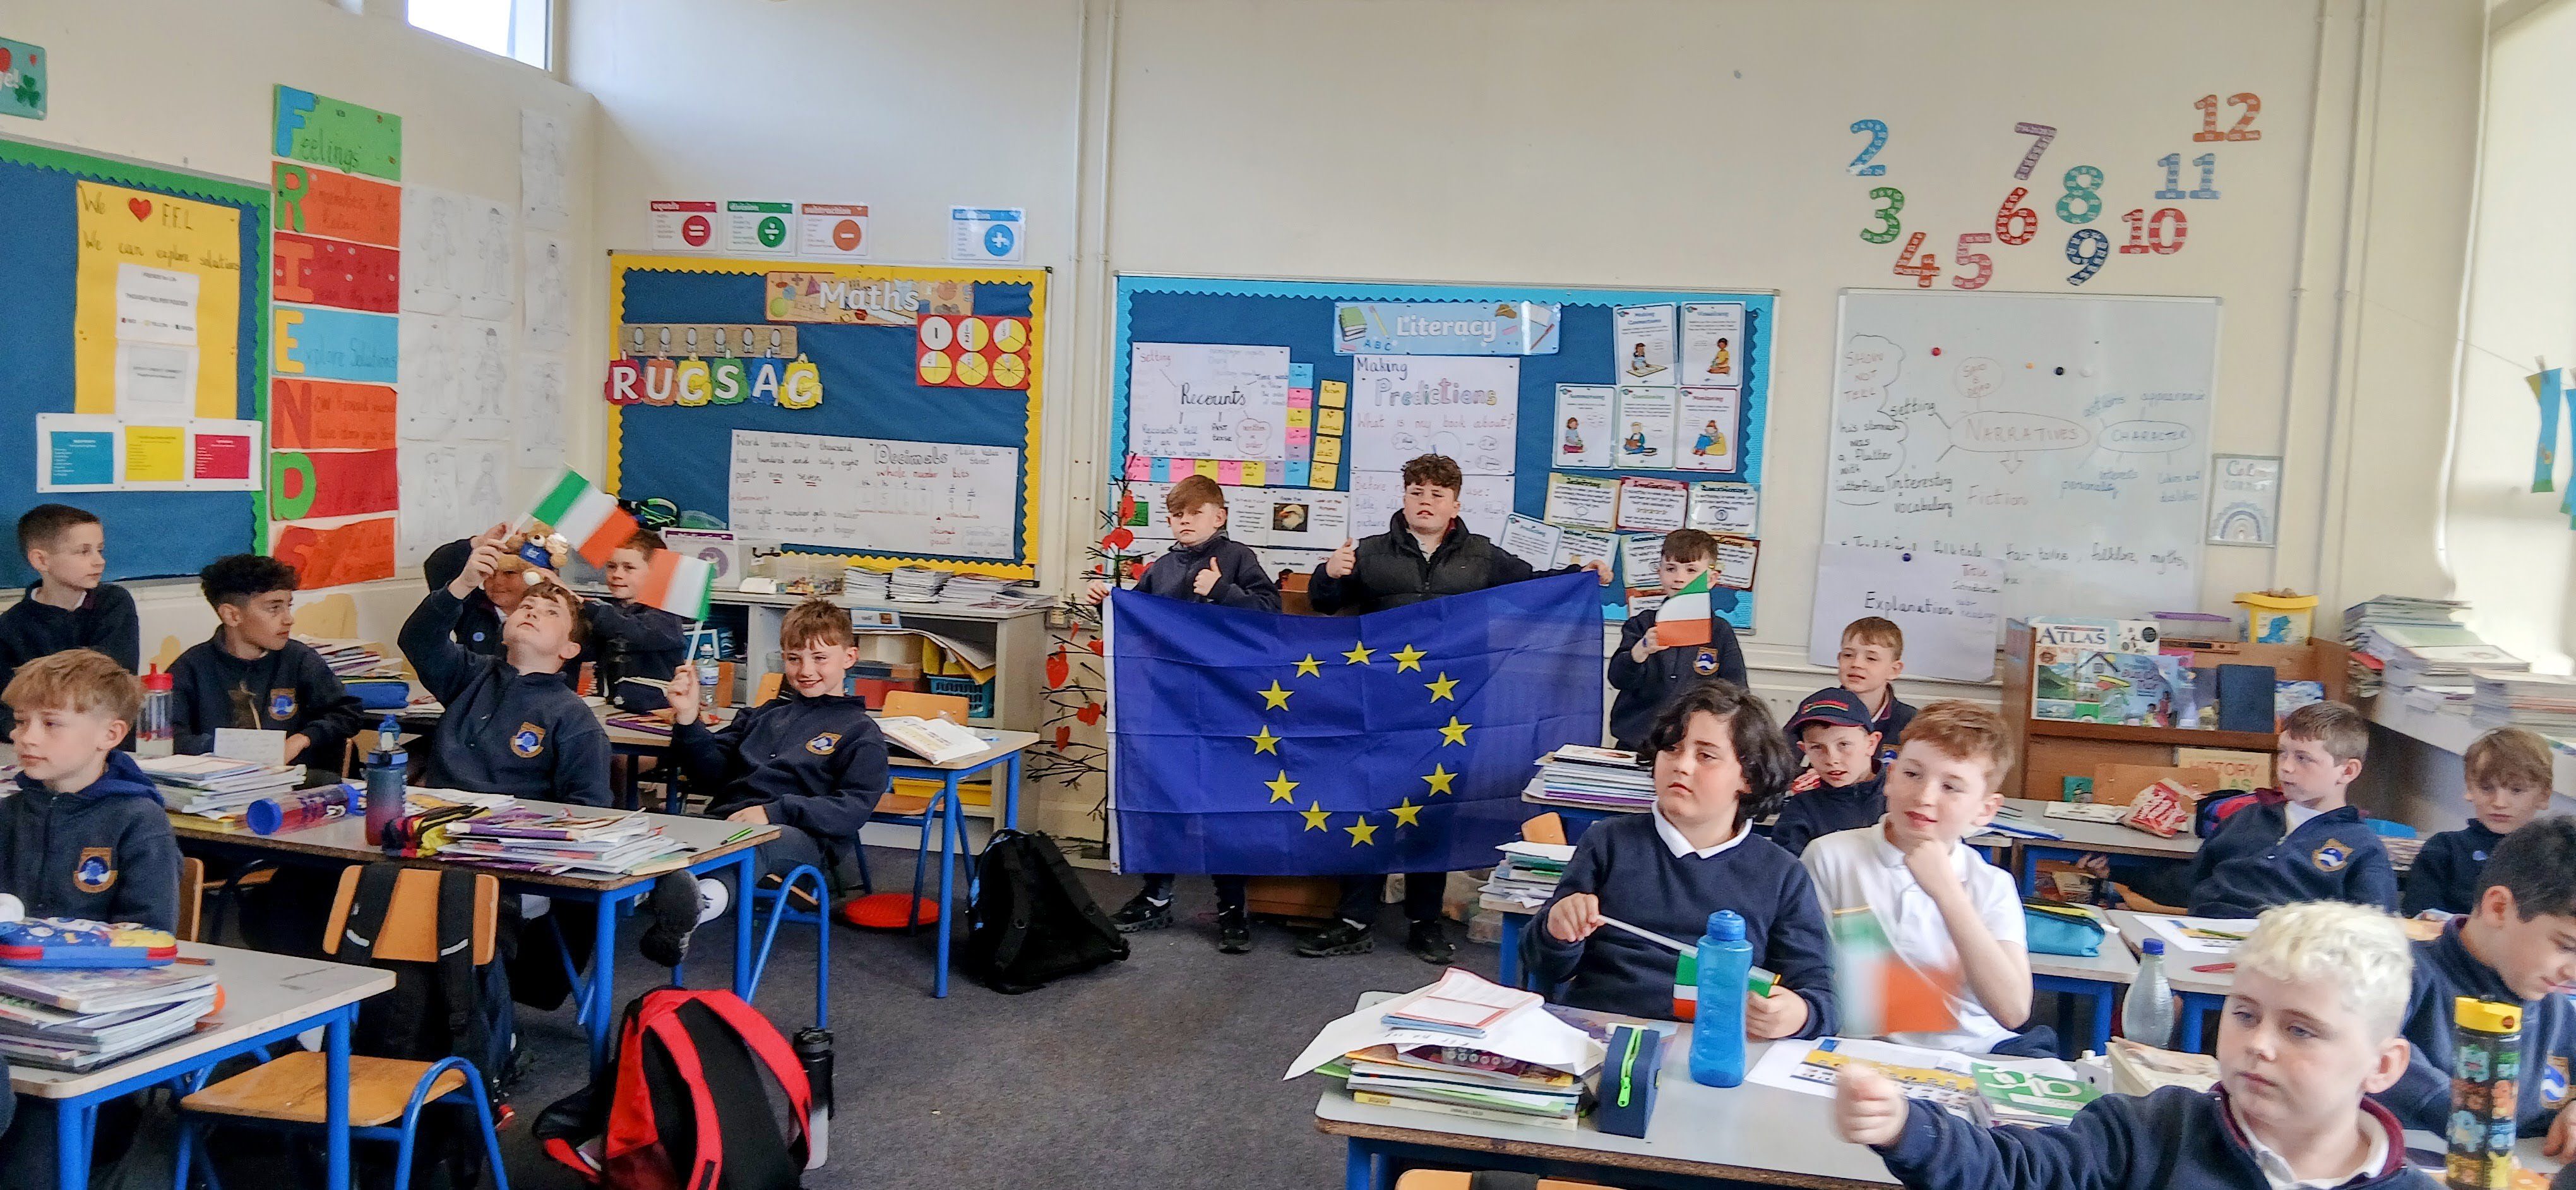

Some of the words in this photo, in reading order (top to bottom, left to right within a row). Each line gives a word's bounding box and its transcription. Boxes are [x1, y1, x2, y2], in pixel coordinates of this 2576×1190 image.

[2192, 92, 2262, 142] 12
[1846, 118, 1888, 177] 2
[2013, 122, 2057, 181] 7
[2055, 165, 2104, 224] 8
[2154, 153, 2221, 200] 11
[1859, 186, 1905, 244] 3
[1996, 186, 2038, 245] 6
[2118, 208, 2188, 255] 10
[1893, 232, 1941, 289] 4
[1952, 232, 1993, 290] 5
[2065, 228, 2110, 287] 9
[820, 281, 920, 312] Maths
[1364, 339, 1372, 348] A
[1374, 340, 1381, 349] B
[1384, 342, 1392, 351] C
[1396, 315, 1497, 342] Literacy
[612, 364, 814, 403] RUCSAC
[1357, 358, 1408, 380] Making
[1375, 378, 1498, 406] Predictions
[1181, 382, 1246, 406] Recounts
[1965, 418, 2080, 442] NARRATIVES
[874, 444, 948, 465] Decimals
[2036, 625, 2107, 645] ATLAS
